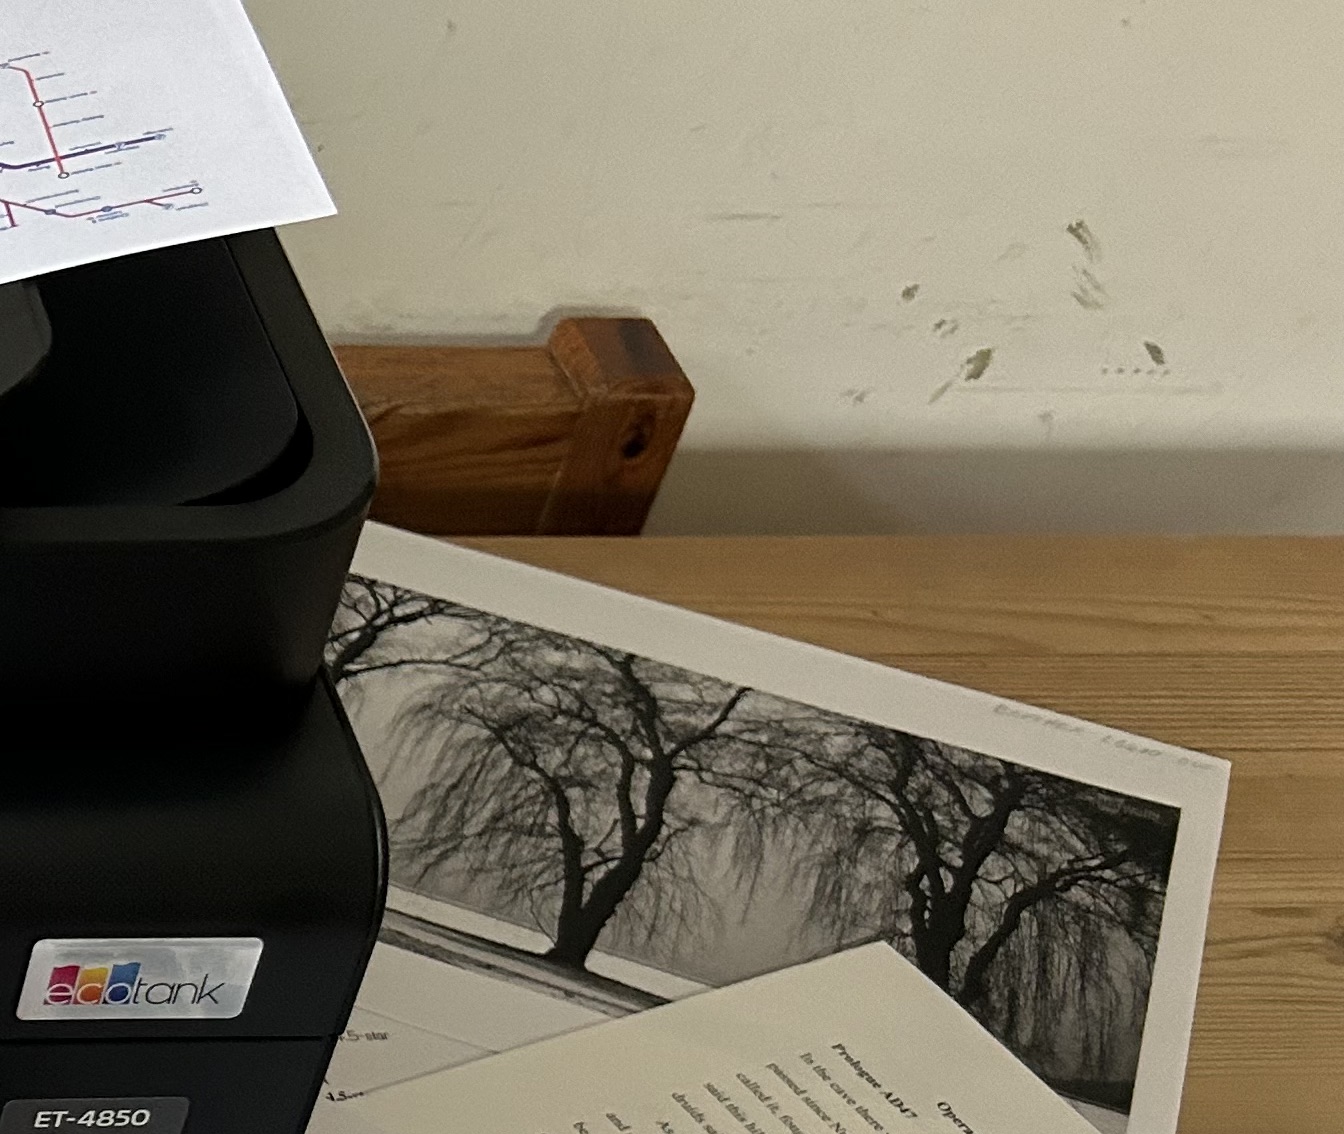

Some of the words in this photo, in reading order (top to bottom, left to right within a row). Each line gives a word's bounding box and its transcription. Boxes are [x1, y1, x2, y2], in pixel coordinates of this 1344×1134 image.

[45, 973, 225, 1005] ecotank
[830, 1043, 883, 1089] Prologue
[879, 1091, 919, 1120] AD47
[34, 1109, 151, 1128] ET-4850
